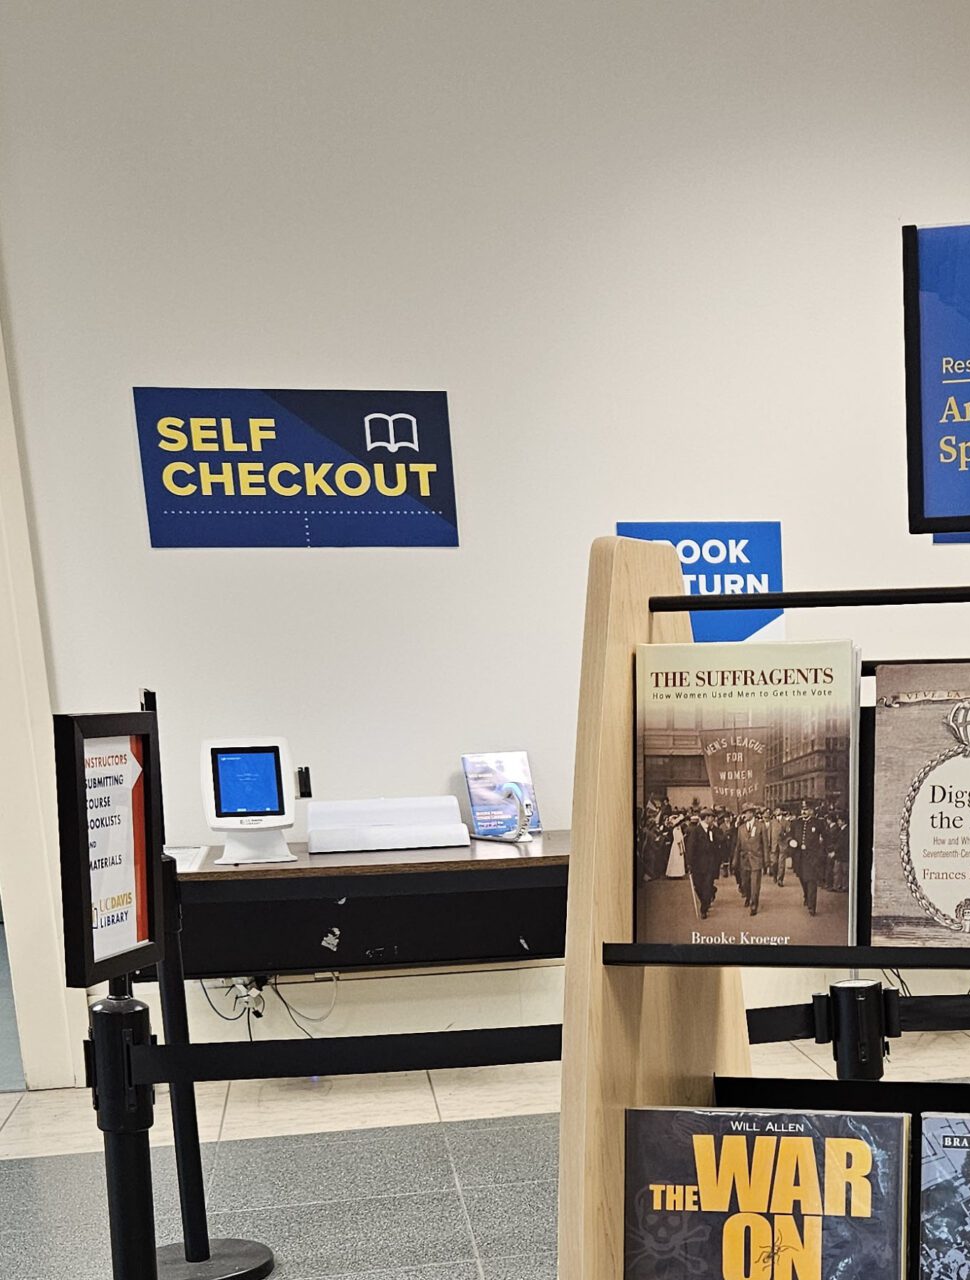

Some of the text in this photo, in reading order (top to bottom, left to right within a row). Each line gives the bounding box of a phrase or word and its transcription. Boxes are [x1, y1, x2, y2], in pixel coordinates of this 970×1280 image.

[157, 417, 276, 452] SELF
[161, 462, 437, 497] CHECKOUT
[654, 539, 750, 564] OOK
[650, 667, 834, 688] THE SUFFRAGENTS
[652, 692, 671, 700] How
[712, 691, 733, 699] Used
[737, 690, 756, 698] Men
[759, 690, 769, 698] to
[772, 689, 788, 697] Get
[792, 689, 807, 697] the
[730, 736, 766, 754] LEAGUE
[84, 753, 128, 769] NSTRUCTORS
[726, 752, 743, 763] FOR
[719, 770, 753, 780] WOMEN
[87, 796, 111, 810] OURSE
[88, 815, 122, 830] OOKLISTS
[930, 810, 964, 829] the
[933, 836, 946, 846] How
[948, 836, 960, 846] and
[922, 868, 966, 881] Frances
[100, 909, 129, 929] LIBRARY
[691, 931, 790, 946] Brooke Kroeger
[731, 1121, 805, 1133] WILL ALLEN
[649, 1134, 873, 1218] THE WAR
